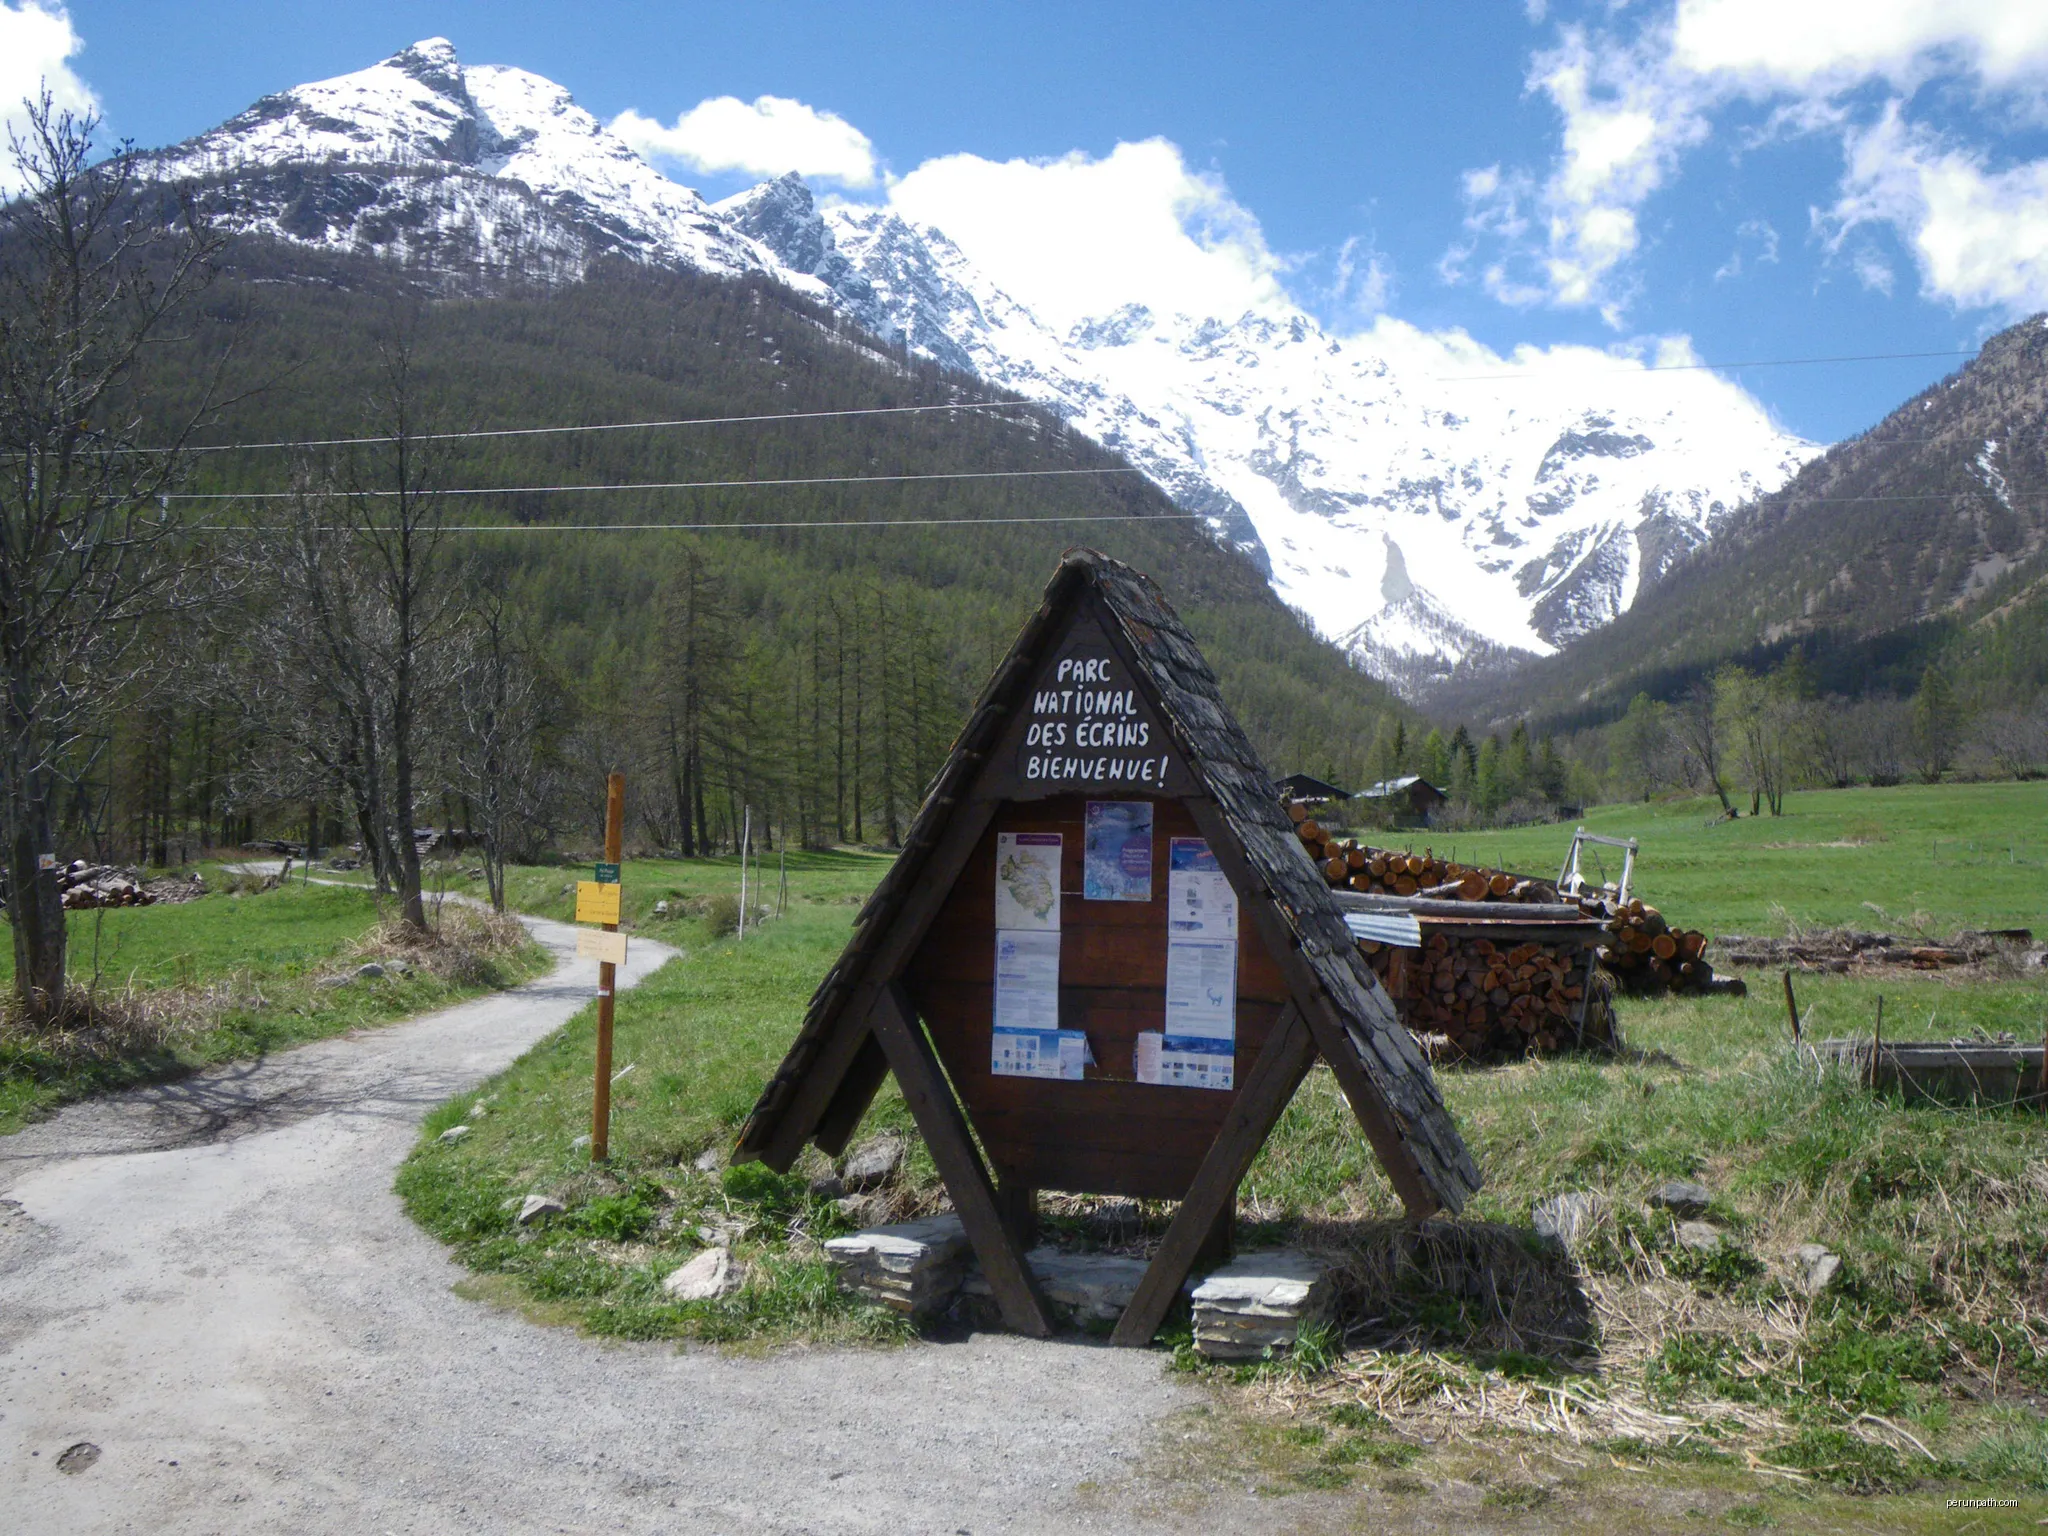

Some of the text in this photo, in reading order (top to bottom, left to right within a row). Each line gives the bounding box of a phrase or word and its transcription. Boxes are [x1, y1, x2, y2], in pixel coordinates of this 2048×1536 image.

[1057, 658, 1111, 682] PARC
[1034, 684, 1137, 715] NATIONAL
[1026, 715, 1149, 747] DES ÉCRINS
